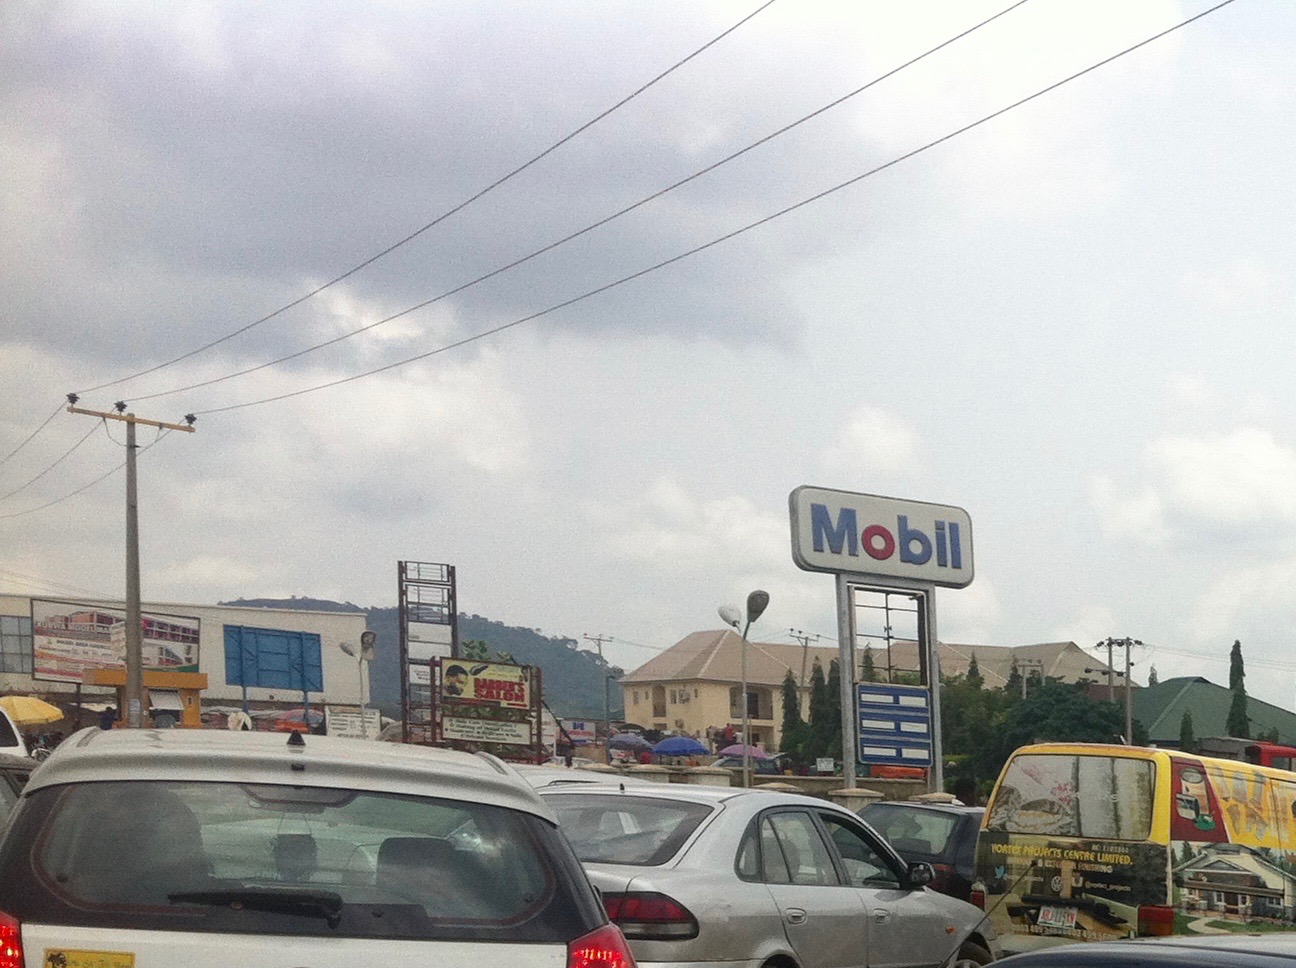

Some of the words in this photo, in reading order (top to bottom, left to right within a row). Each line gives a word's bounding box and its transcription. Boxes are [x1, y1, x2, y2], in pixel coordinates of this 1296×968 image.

[810, 503, 963, 569] Mobil
[474, 689, 525, 702] SALON
[1064, 849, 1095, 861] CENTRE
